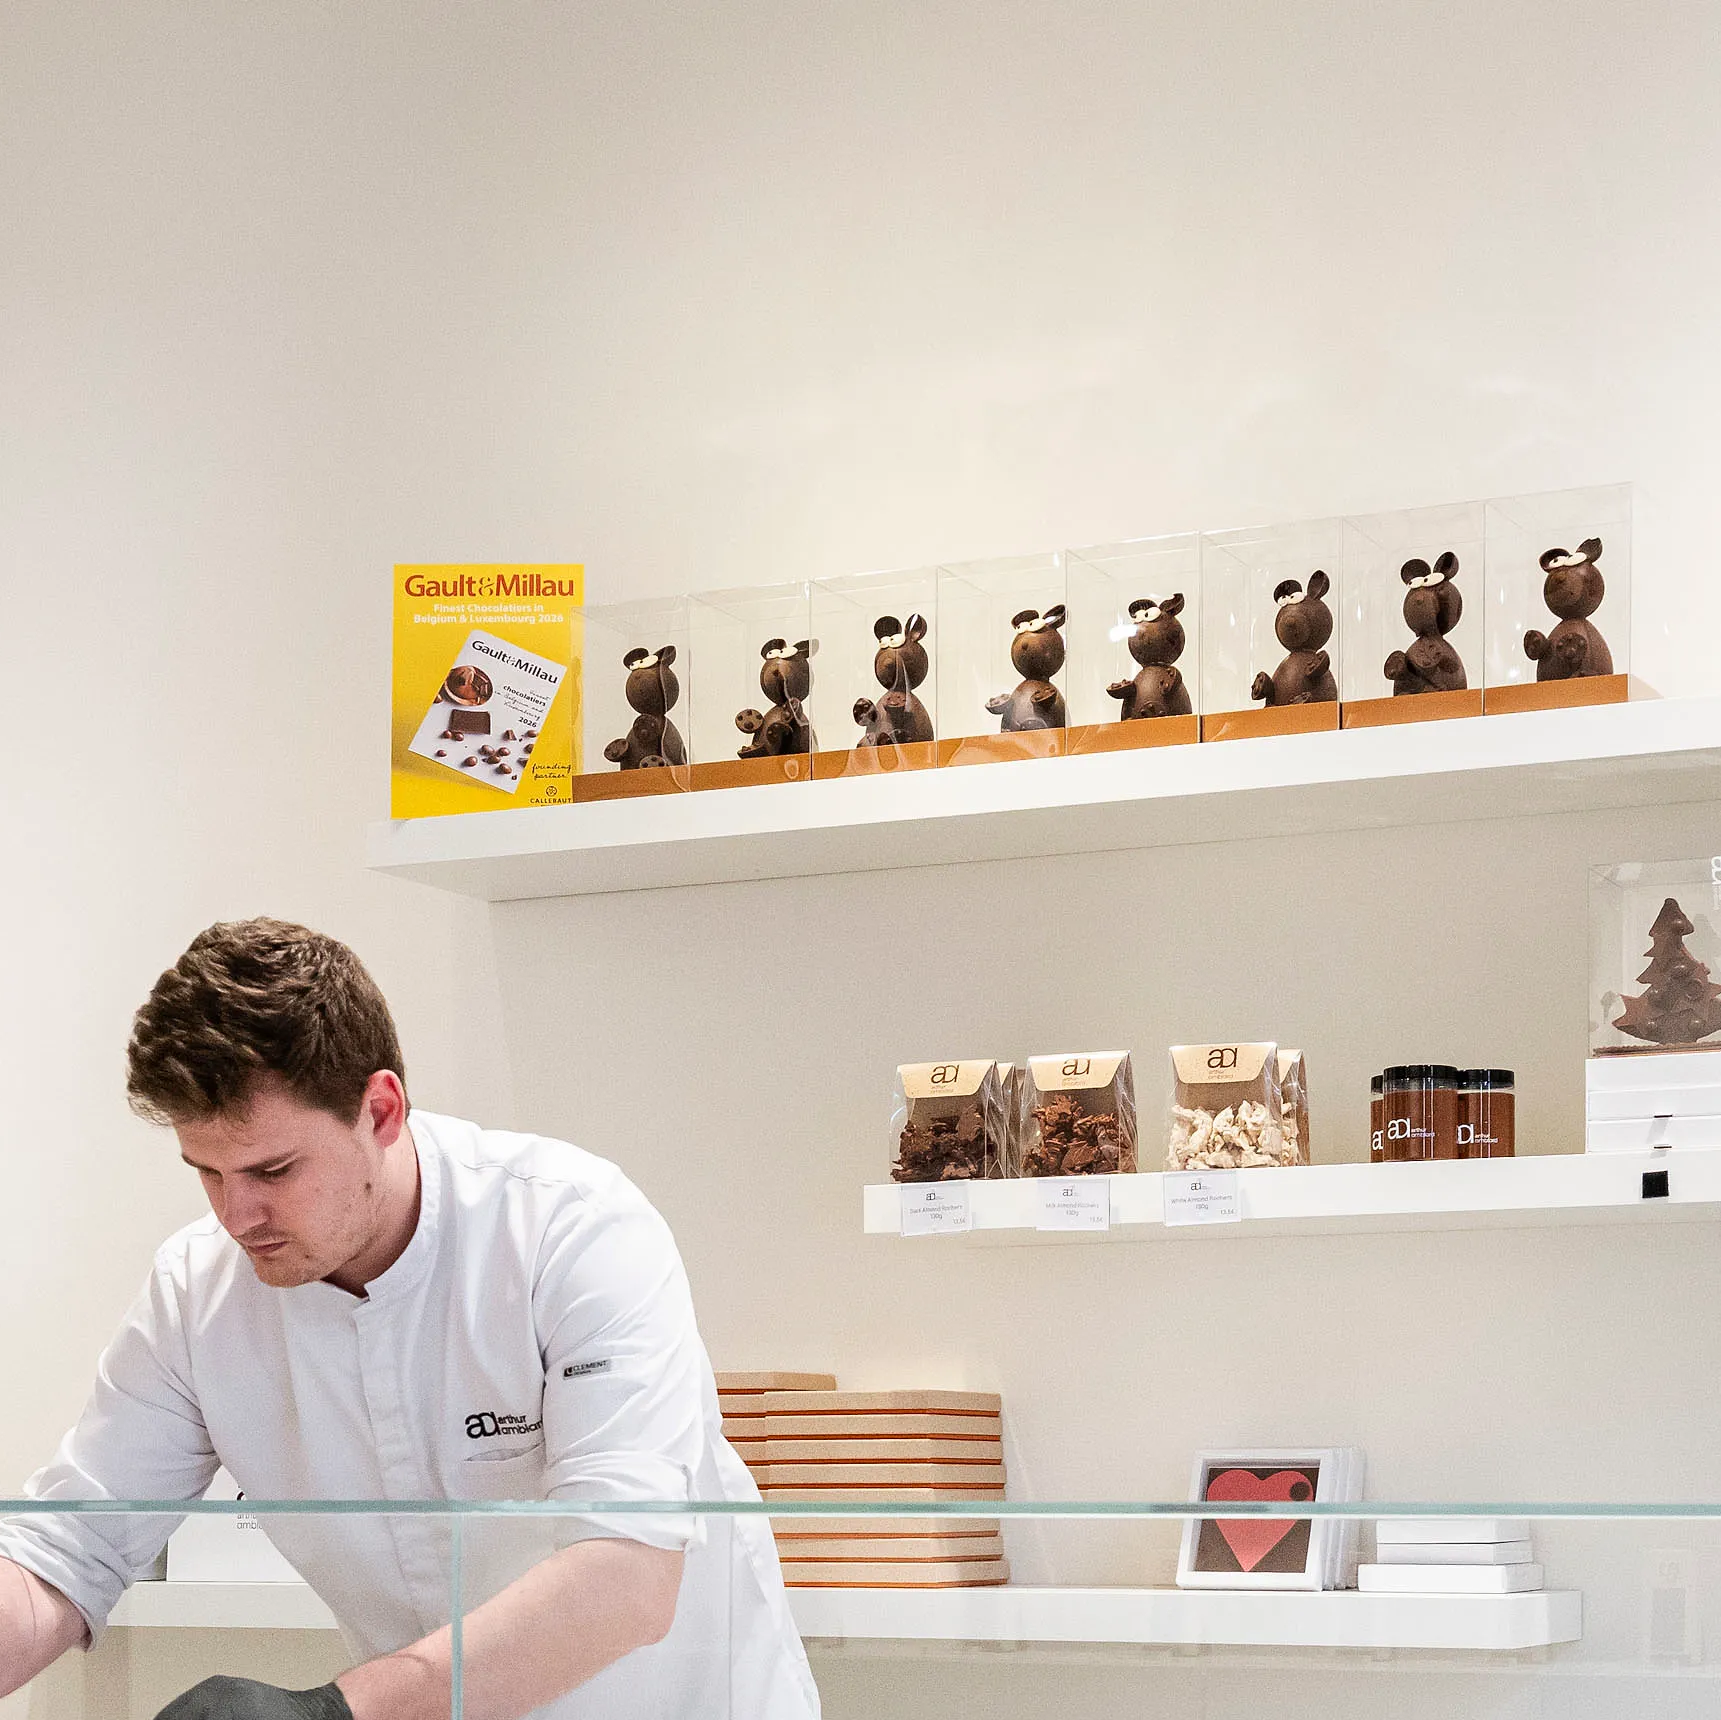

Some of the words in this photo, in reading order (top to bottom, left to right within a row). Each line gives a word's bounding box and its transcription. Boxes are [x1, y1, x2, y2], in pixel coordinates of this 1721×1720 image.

[404, 574, 574, 597] Gault&Millau
[434, 604, 465, 613] Finest
[534, 604, 544, 613] in
[414, 614, 457, 625] Belgium
[470, 614, 536, 625] Luxembourg
[472, 640, 558, 684] Gault&Millau
[518, 716, 537, 728] 2026
[497, 1414, 527, 1425] arthur
[501, 1420, 543, 1435] amblar
